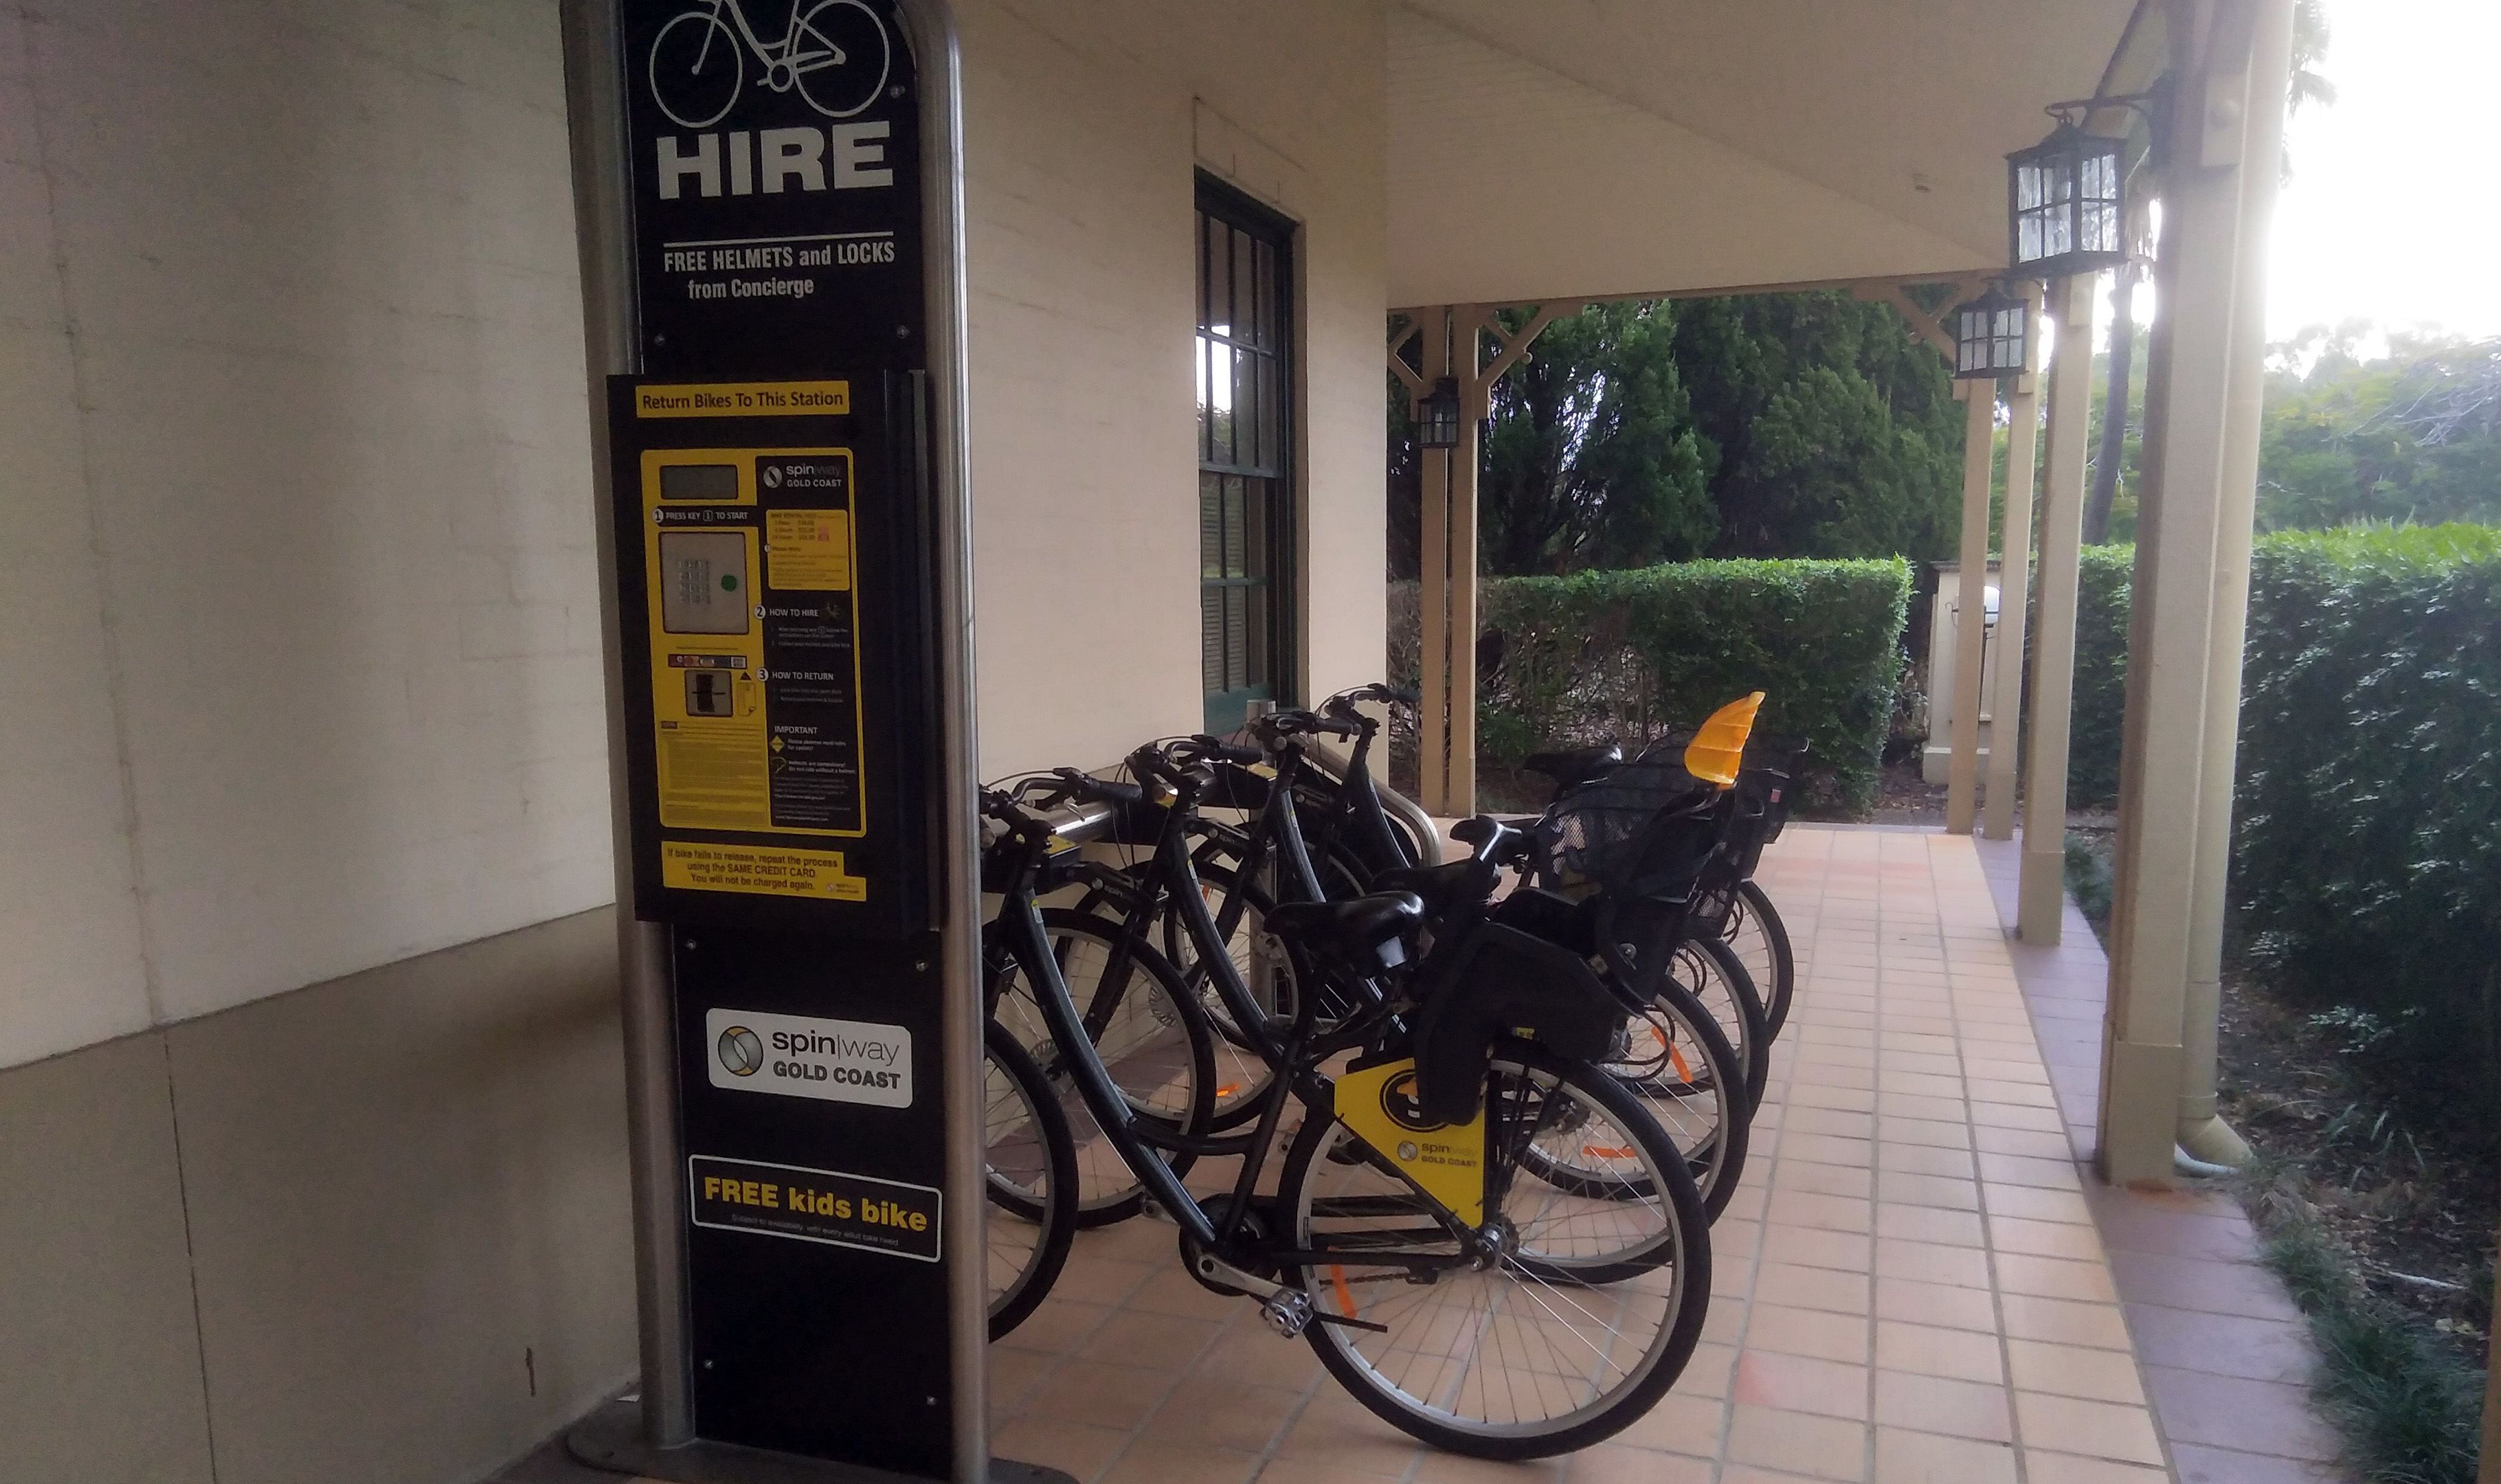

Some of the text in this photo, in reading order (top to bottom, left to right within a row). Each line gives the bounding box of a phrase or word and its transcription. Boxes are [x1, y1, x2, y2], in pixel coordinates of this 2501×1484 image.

[656, 120, 893, 200] HIRE
[664, 241, 895, 272] FREE HELMETS and LOCKS
[688, 277, 814, 299] from Concierge
[642, 391, 843, 409] Return Bikes To This Station
[666, 512, 686, 520] PRESS
[790, 609, 800, 617] TO
[772, 671, 791, 679] HOW
[793, 672, 803, 680] TO
[804, 672, 834, 680] RETURN
[774, 726, 818, 734] IMPORTANT
[668, 848, 673, 857] If
[675, 849, 692, 858] bike
[695, 850, 711, 859] fails
[759, 855, 785, 866] repeat
[787, 855, 800, 864] the
[804, 859, 838, 868] process
[687, 863, 816, 877] using the SAME CREDIT CARD
[691, 873, 706, 882] You
[708, 875, 723, 884] will
[726, 876, 739, 884] not
[741, 877, 751, 886] be
[754, 877, 787, 889] charged
[773, 1061, 901, 1089] GOLD COAST
[1422, 1155, 1477, 1167] GOLD COAST
[704, 1176, 927, 1231] FREE kids bike
